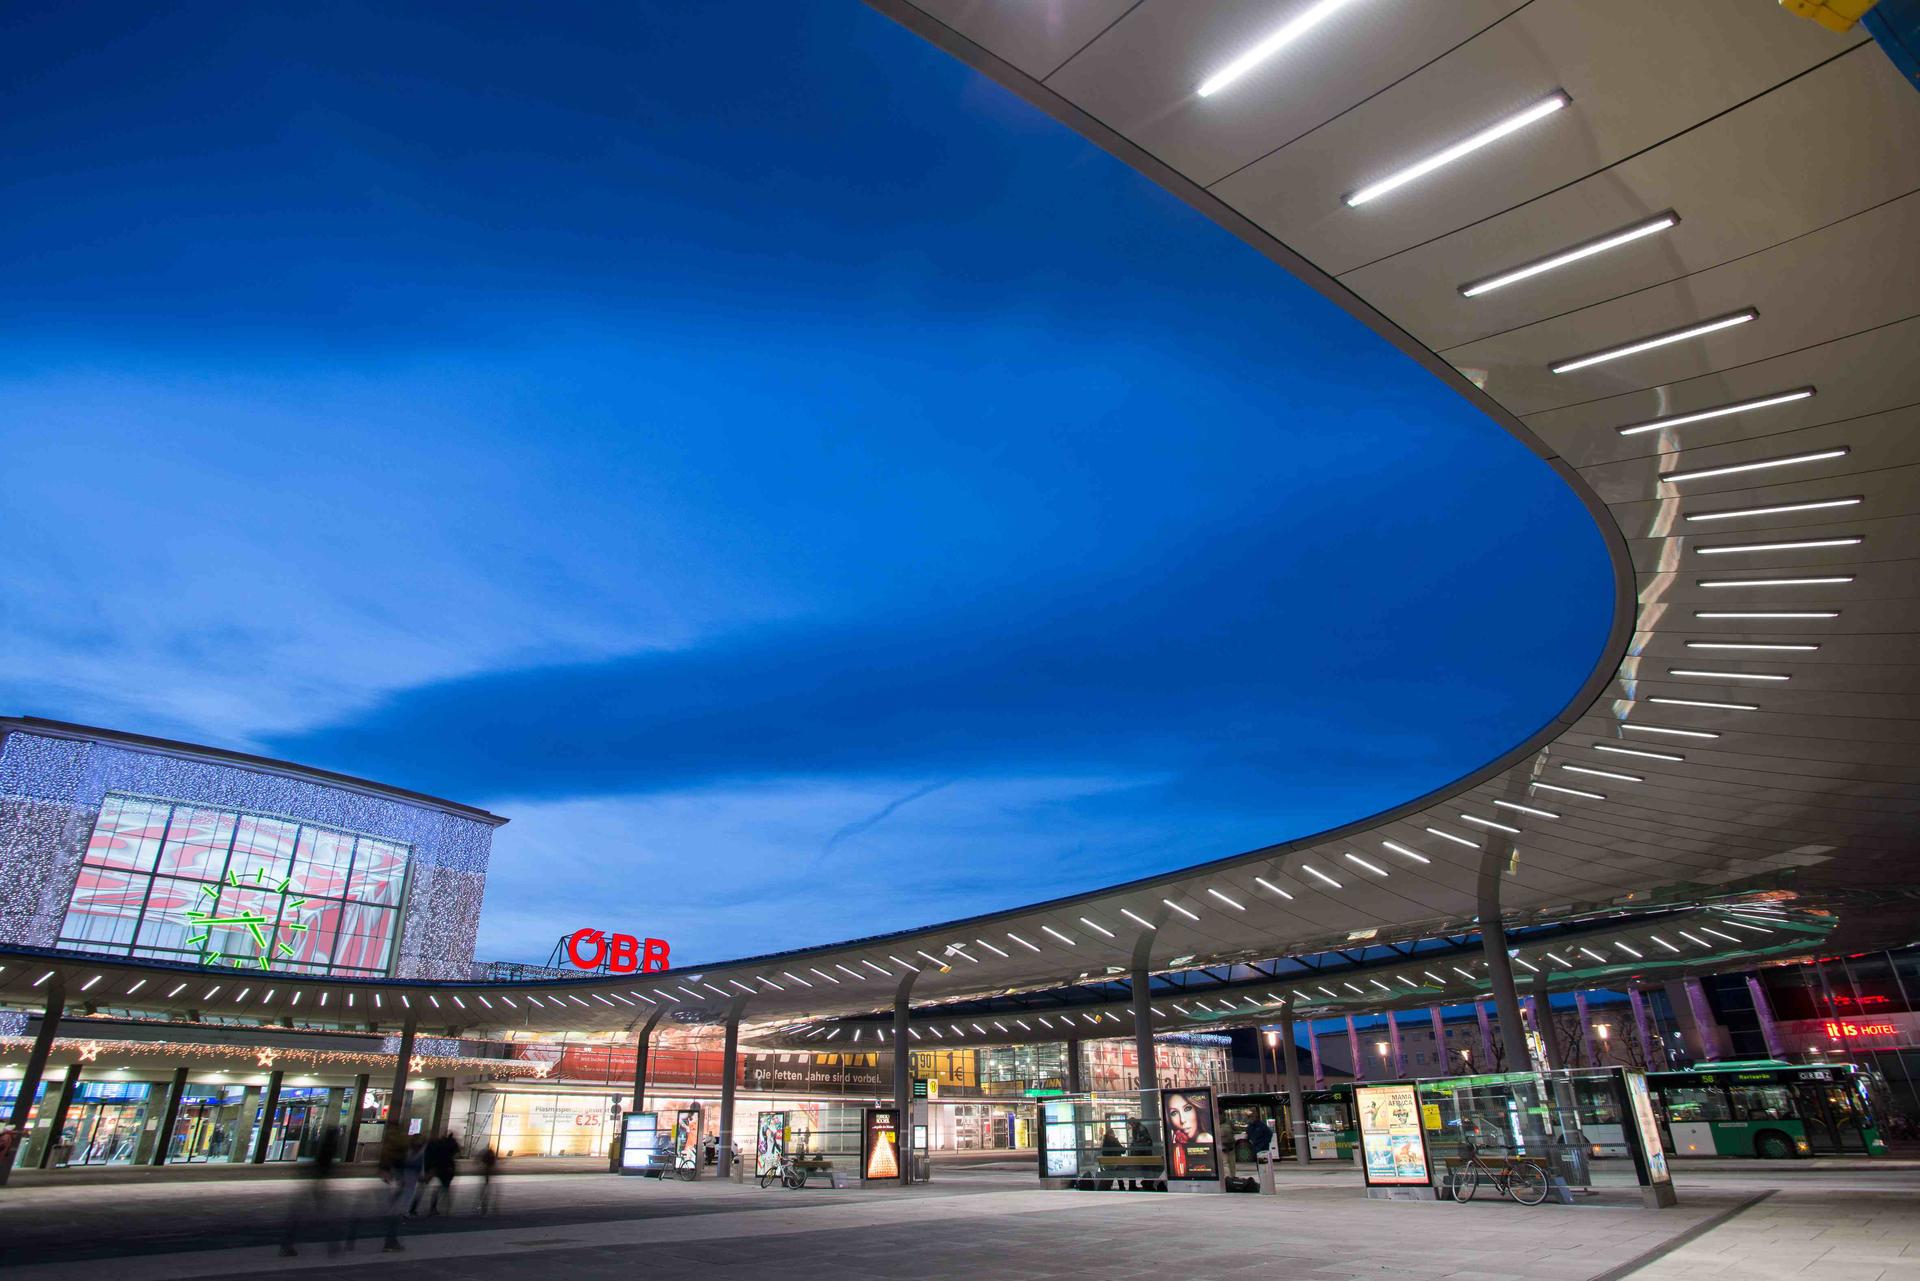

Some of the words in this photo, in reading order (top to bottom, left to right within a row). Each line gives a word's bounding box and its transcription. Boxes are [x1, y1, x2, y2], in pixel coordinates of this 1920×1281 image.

[568, 928, 670, 973] ÖBB
[1860, 1024, 1897, 1034] HOTEL
[754, 1069, 772, 1080] Die
[774, 1069, 802, 1081] fetten
[805, 1071, 831, 1082] Jahre
[1031, 1079, 1062, 1089] FTINN
